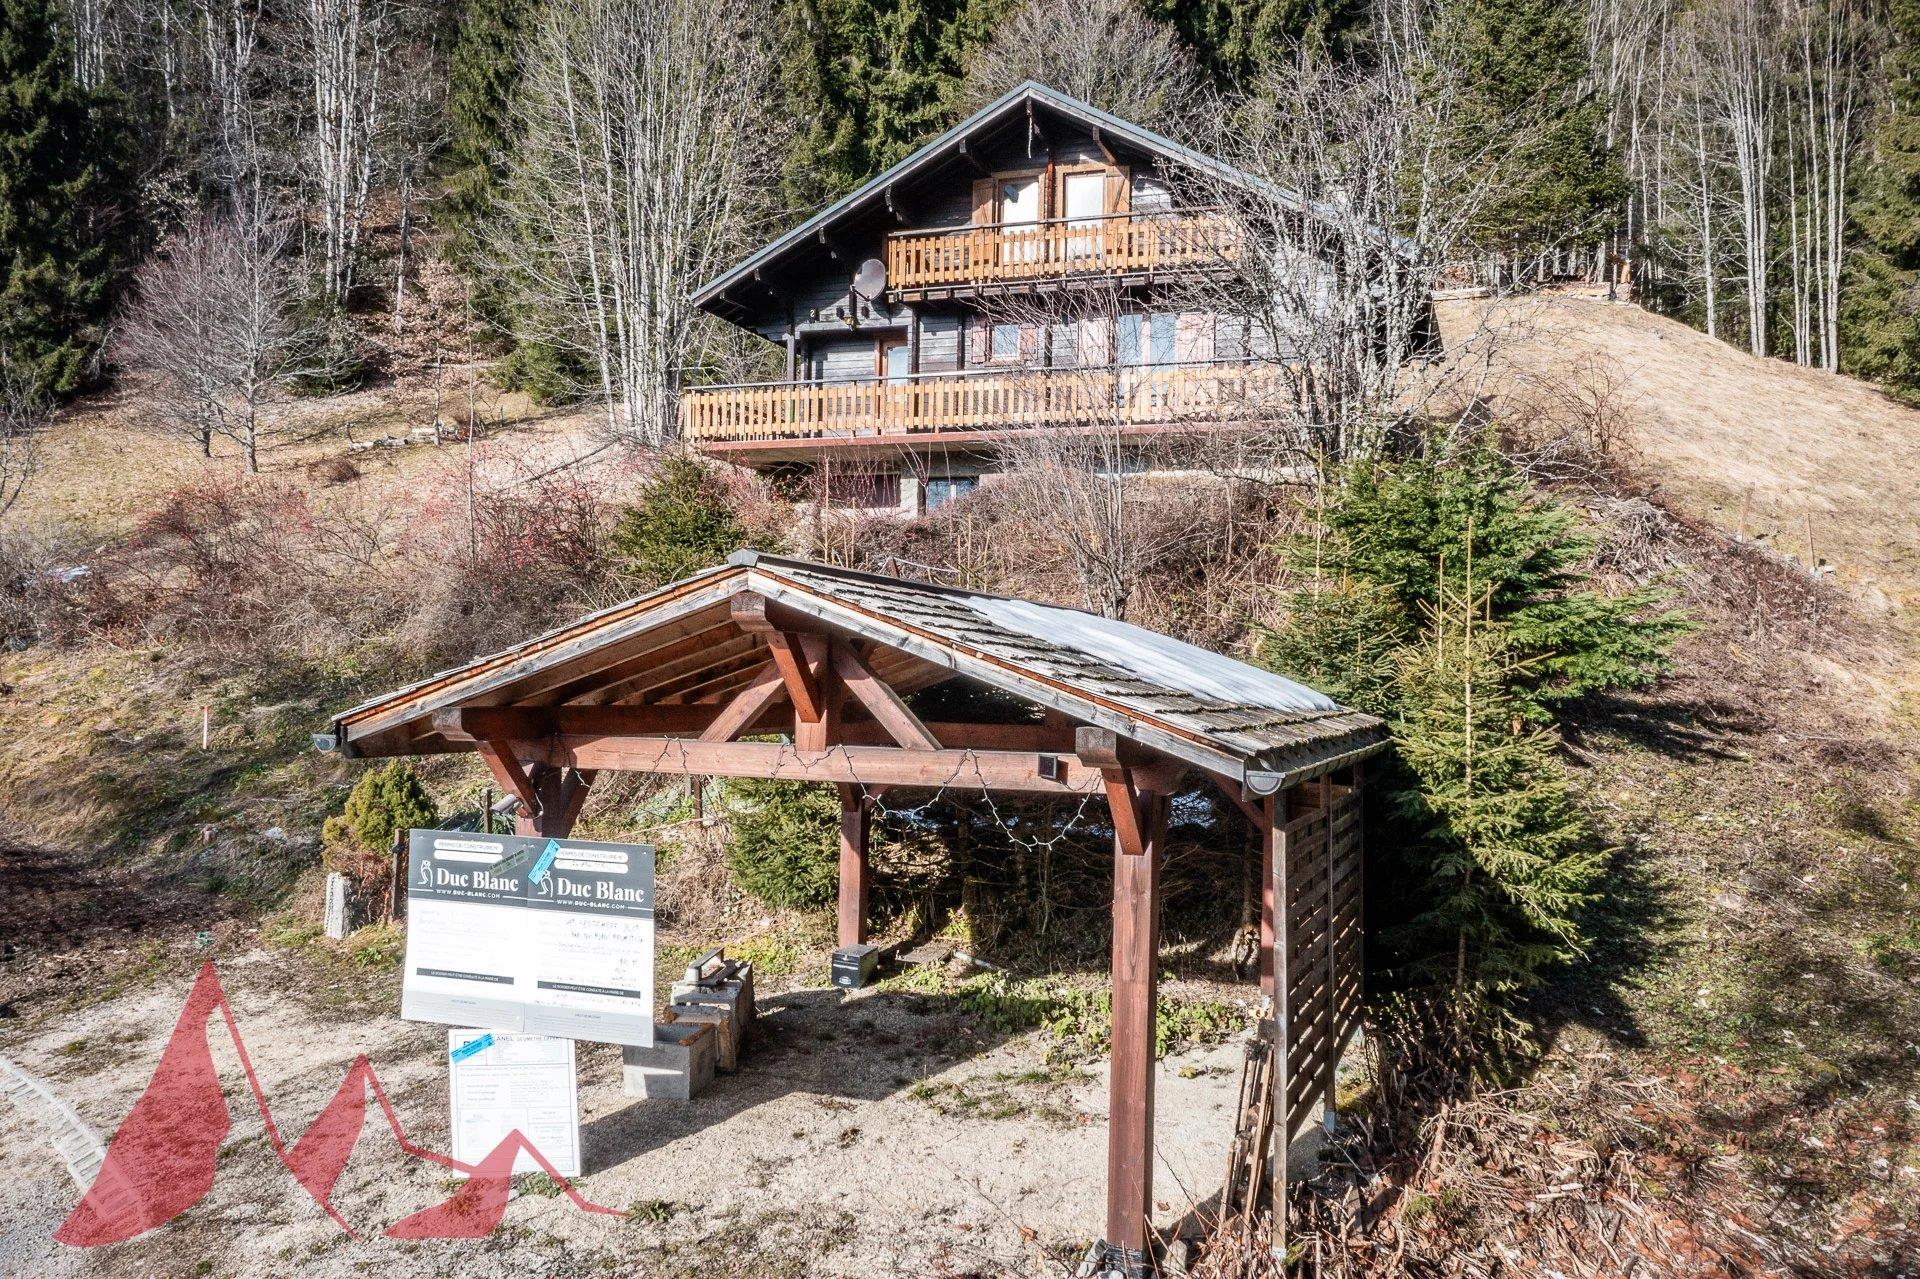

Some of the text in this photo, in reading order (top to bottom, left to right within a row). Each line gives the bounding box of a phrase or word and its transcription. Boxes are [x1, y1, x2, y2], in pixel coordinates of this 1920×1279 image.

[436, 867, 519, 892] Duc Blanc
[436, 889, 501, 898] WWW.DUC-BLANC.COM
[557, 877, 644, 902] Duc Blanc
[556, 899, 625, 909] WWW.DUC-BLANC.COM
